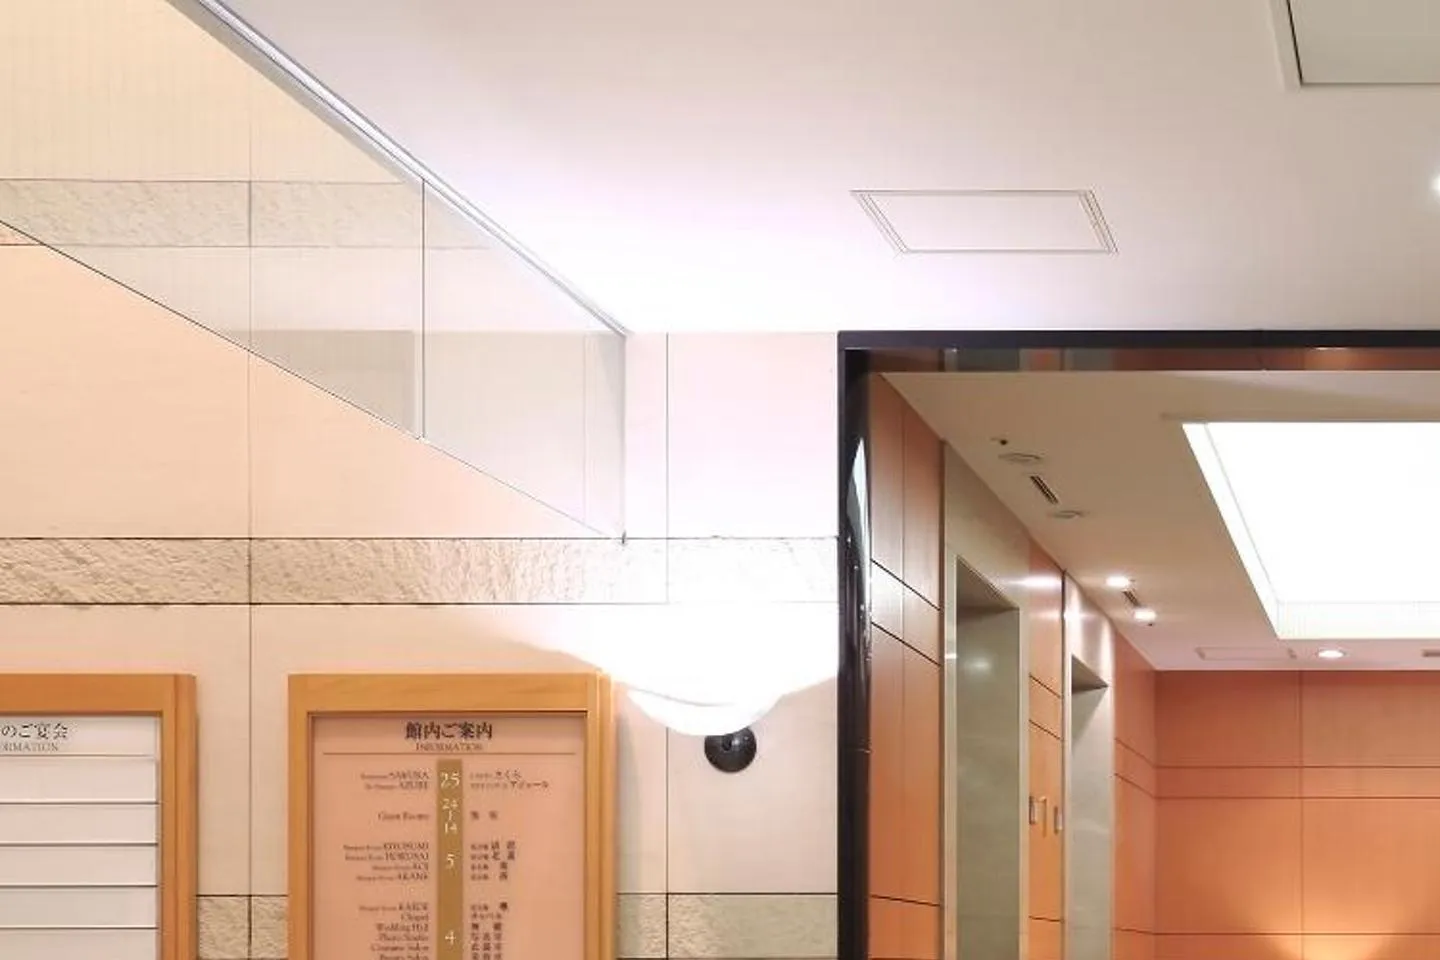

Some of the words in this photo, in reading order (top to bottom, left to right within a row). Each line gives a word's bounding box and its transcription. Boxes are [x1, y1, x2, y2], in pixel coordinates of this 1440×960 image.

[405, 721, 493, 740] 館内ご案内
[416, 742, 484, 752] INFORMATION
[440, 771, 460, 788] 25
[445, 931, 457, 945] 4
